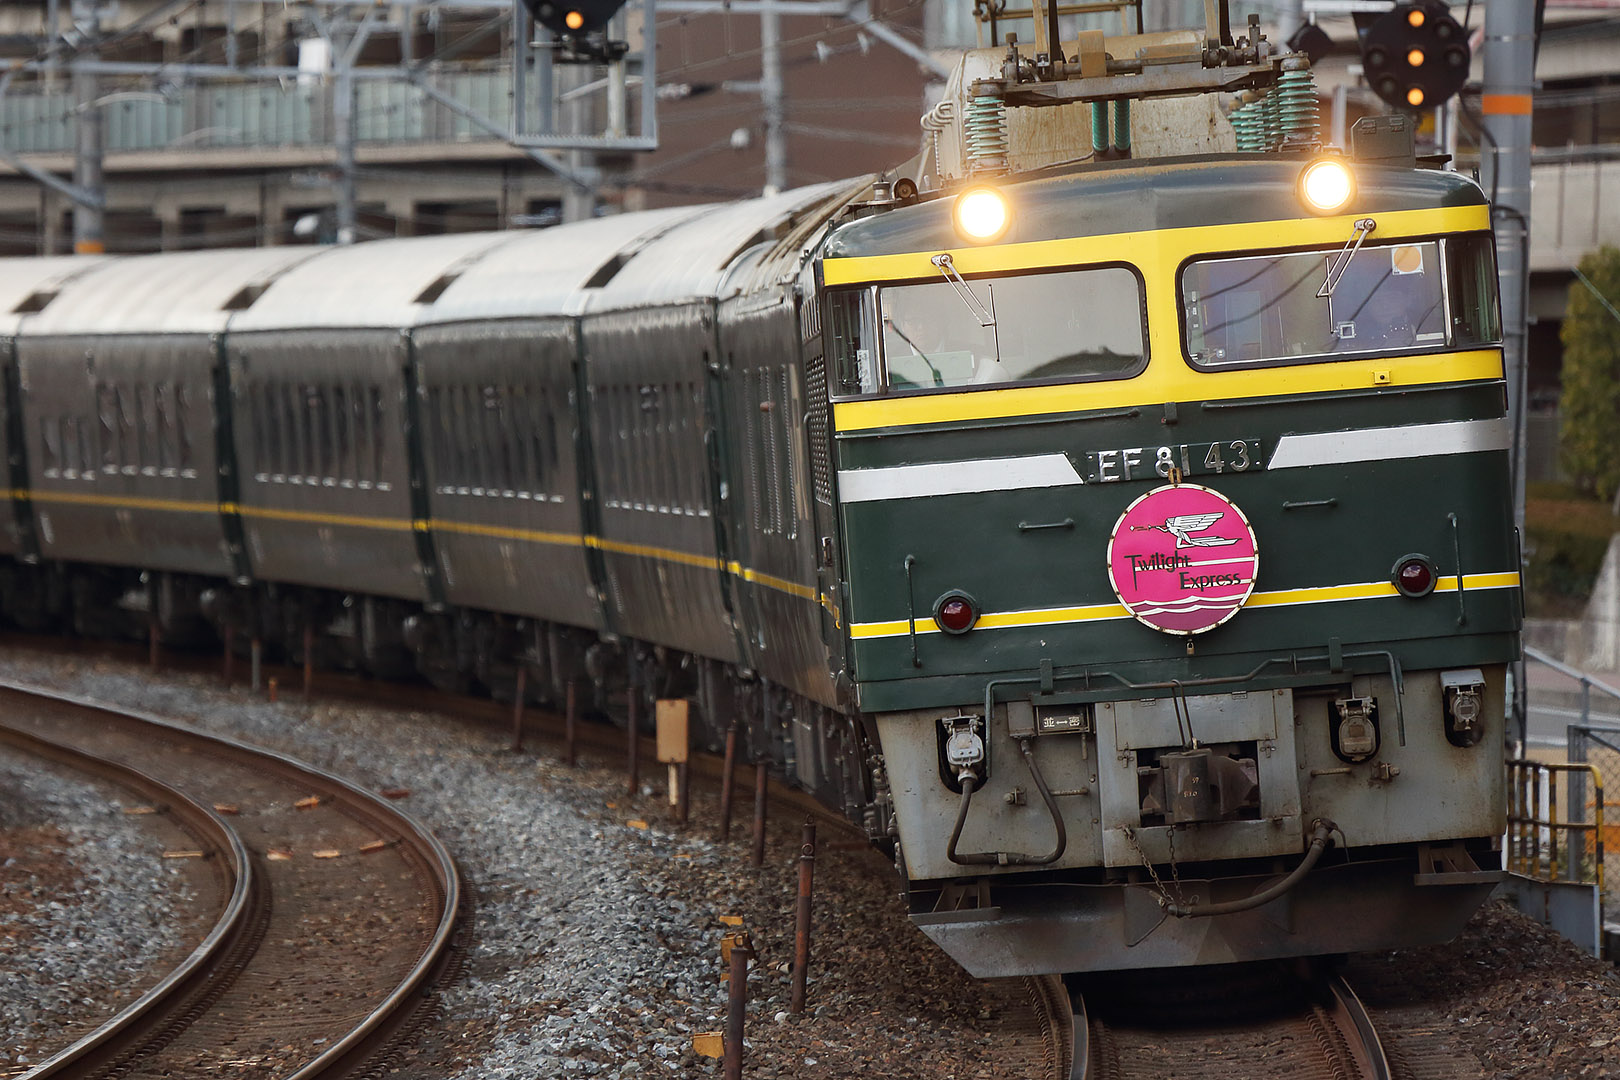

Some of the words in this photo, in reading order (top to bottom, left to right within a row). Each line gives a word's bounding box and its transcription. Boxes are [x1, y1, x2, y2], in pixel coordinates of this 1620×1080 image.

[1098, 448, 1142, 482] EF
[1155, 446, 1191, 478] 81
[1204, 440, 1250, 473] 43
[1124, 550, 1192, 591] Twilight
[1179, 571, 1241, 592] Express
